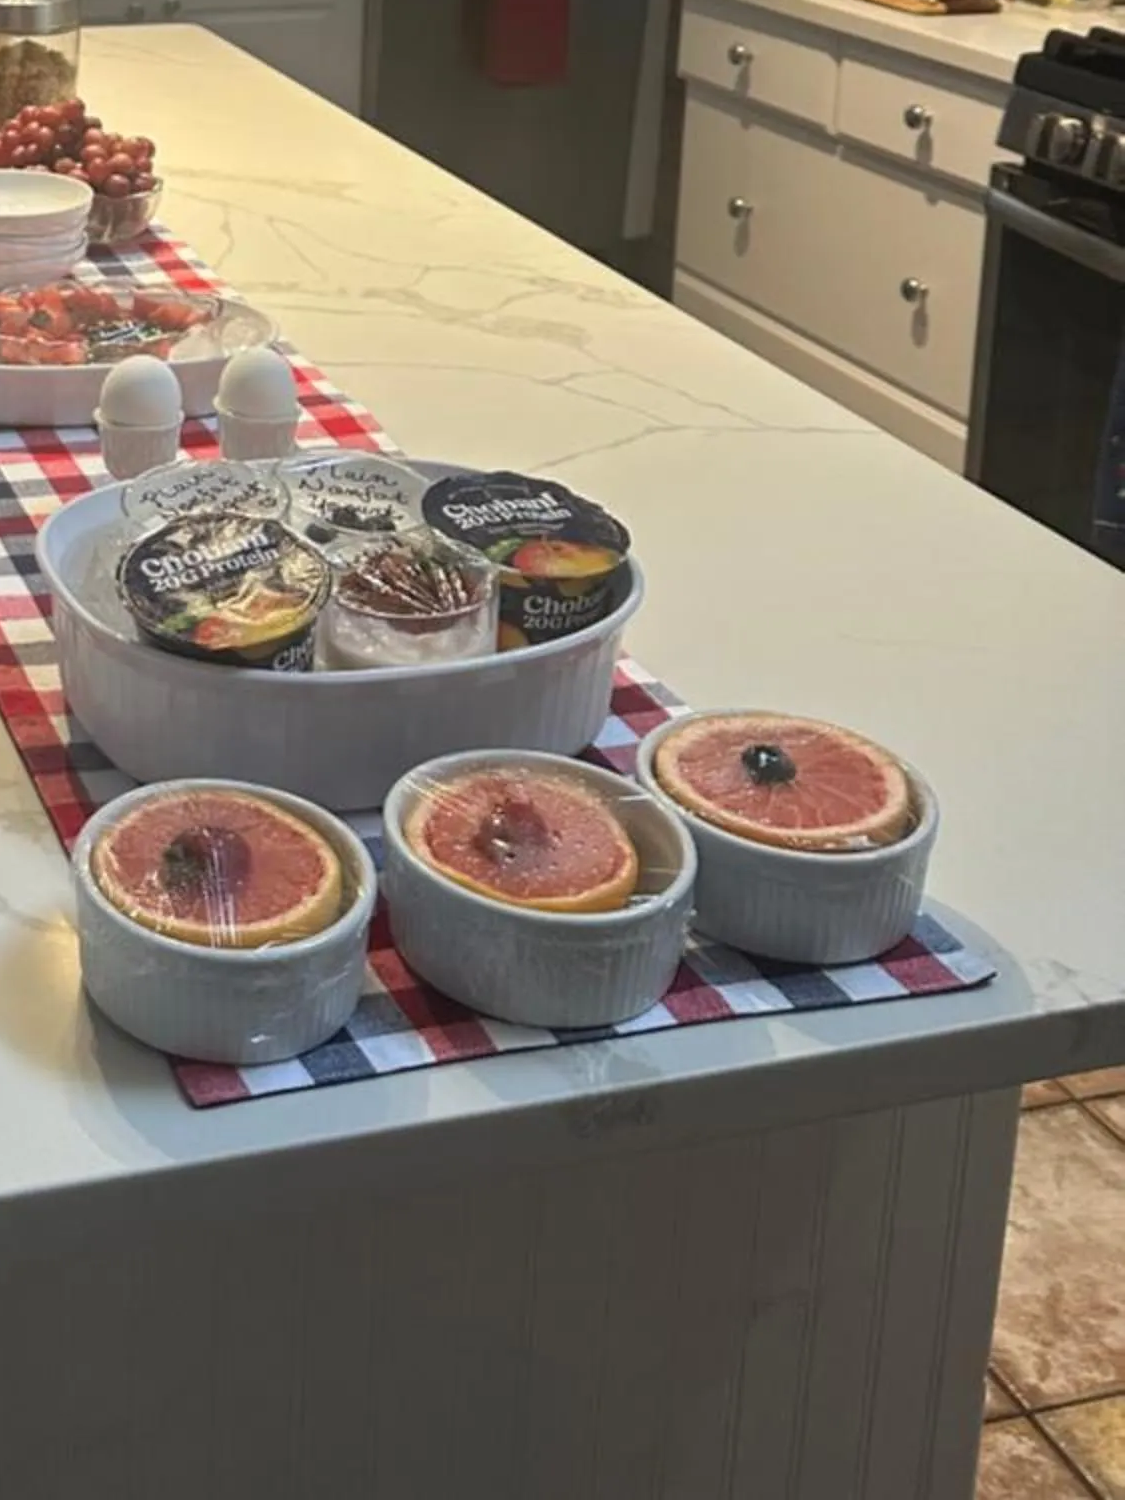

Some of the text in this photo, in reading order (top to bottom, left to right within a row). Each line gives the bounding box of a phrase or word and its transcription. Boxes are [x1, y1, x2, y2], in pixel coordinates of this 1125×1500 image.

[442, 490, 559, 518] Chobani
[455, 511, 497, 530] 20G
[500, 507, 572, 522] Protein
[149, 569, 199, 593] 20G
[200, 547, 280, 578] Protein
[523, 614, 563, 629] 20G
